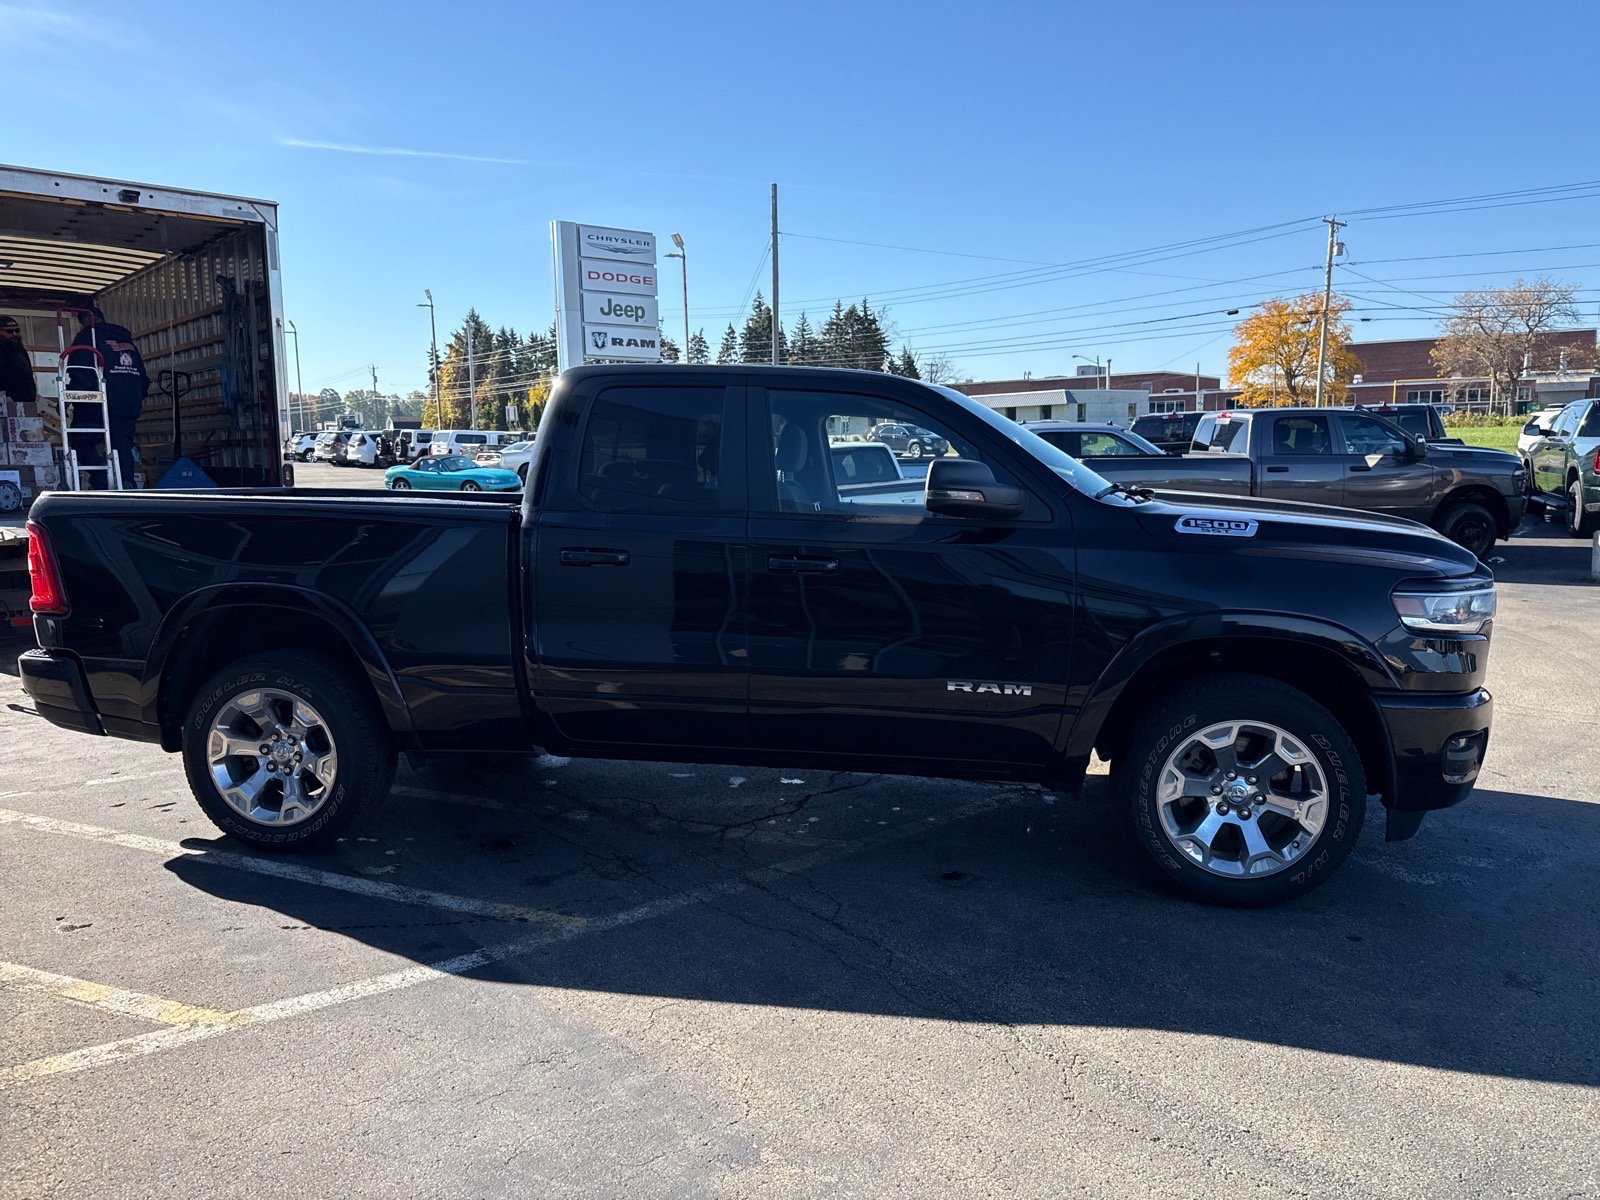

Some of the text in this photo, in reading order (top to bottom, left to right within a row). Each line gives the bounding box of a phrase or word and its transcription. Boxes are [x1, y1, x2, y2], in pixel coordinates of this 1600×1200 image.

[587, 234, 651, 247] CHRYSLER
[588, 270, 654, 286] DODGE
[600, 298, 646, 322] Jeep
[611, 337, 656, 349] RAM
[1189, 519, 1246, 530] 1500
[946, 680, 1033, 696] RAM
